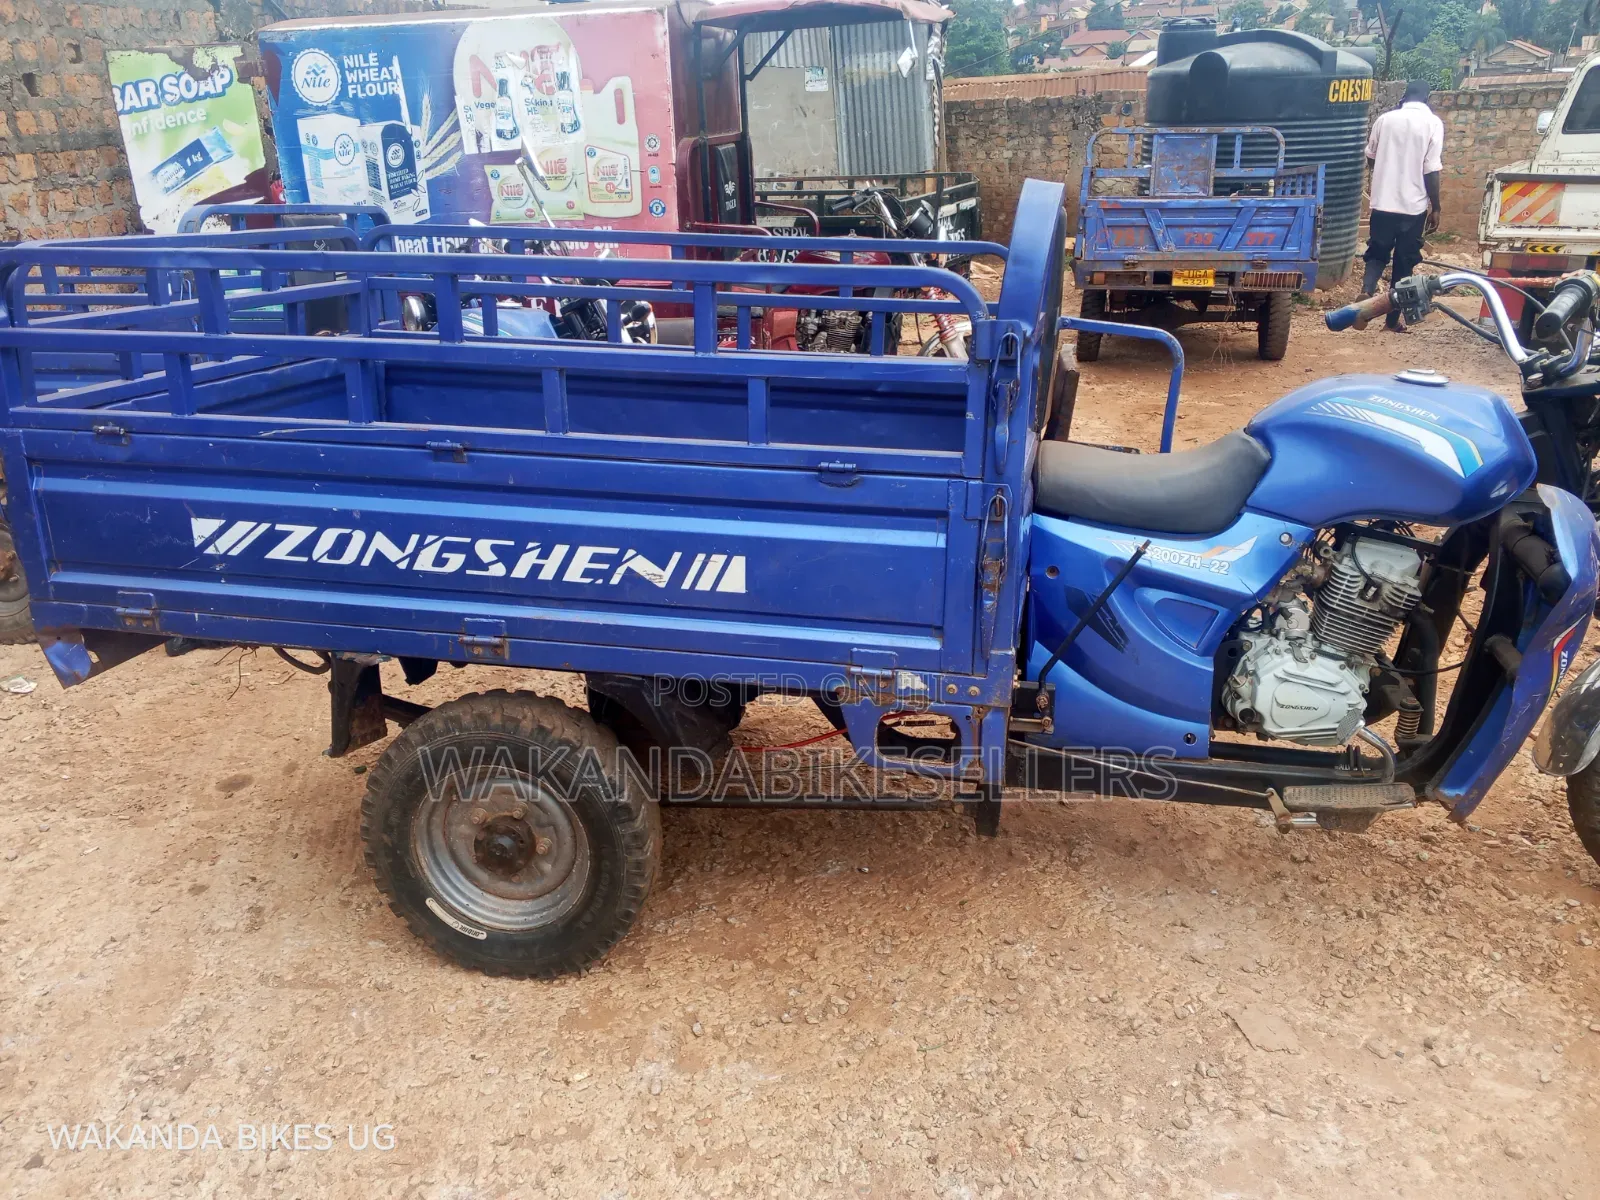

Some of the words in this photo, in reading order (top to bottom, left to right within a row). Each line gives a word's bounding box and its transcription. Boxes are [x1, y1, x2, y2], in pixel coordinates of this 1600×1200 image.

[343, 52, 379, 69] NILE
[162, 65, 231, 102] SOAP
[301, 77, 331, 89] Nile
[345, 66, 400, 84] WHEAT
[347, 81, 400, 98] FLOUR
[130, 106, 208, 137] nfidence
[1187, 270, 1209, 279] UGA
[1368, 394, 1441, 421] ZONGSHEN
[264, 522, 682, 588] ZONGSHEN
